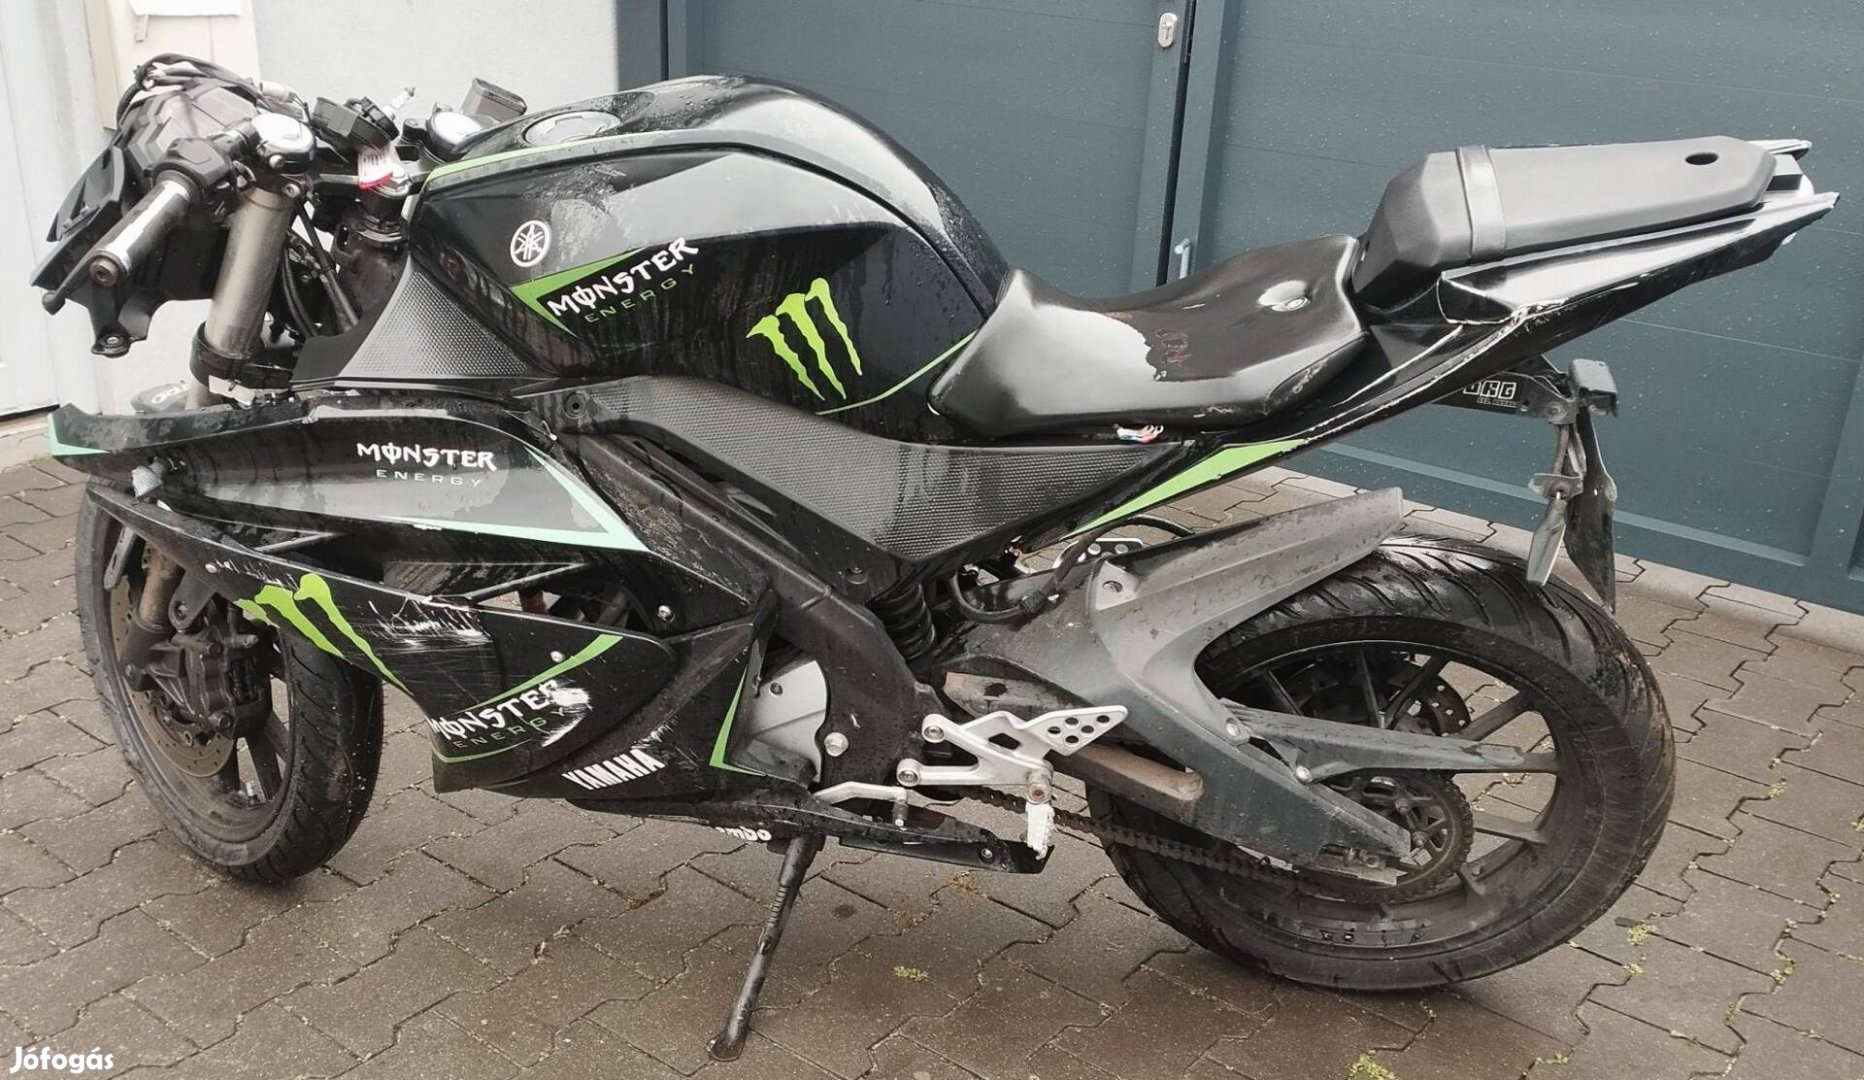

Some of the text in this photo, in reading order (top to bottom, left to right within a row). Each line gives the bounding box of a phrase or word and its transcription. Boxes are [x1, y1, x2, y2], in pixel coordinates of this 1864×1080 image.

[547, 237, 699, 317] MONSTER
[584, 263, 695, 323] ENERGY
[356, 442, 497, 471] MONSTER
[376, 469, 483, 487] ENERGY
[453, 706, 566, 748] ENERGY
[561, 748, 666, 790] YAMAHA
